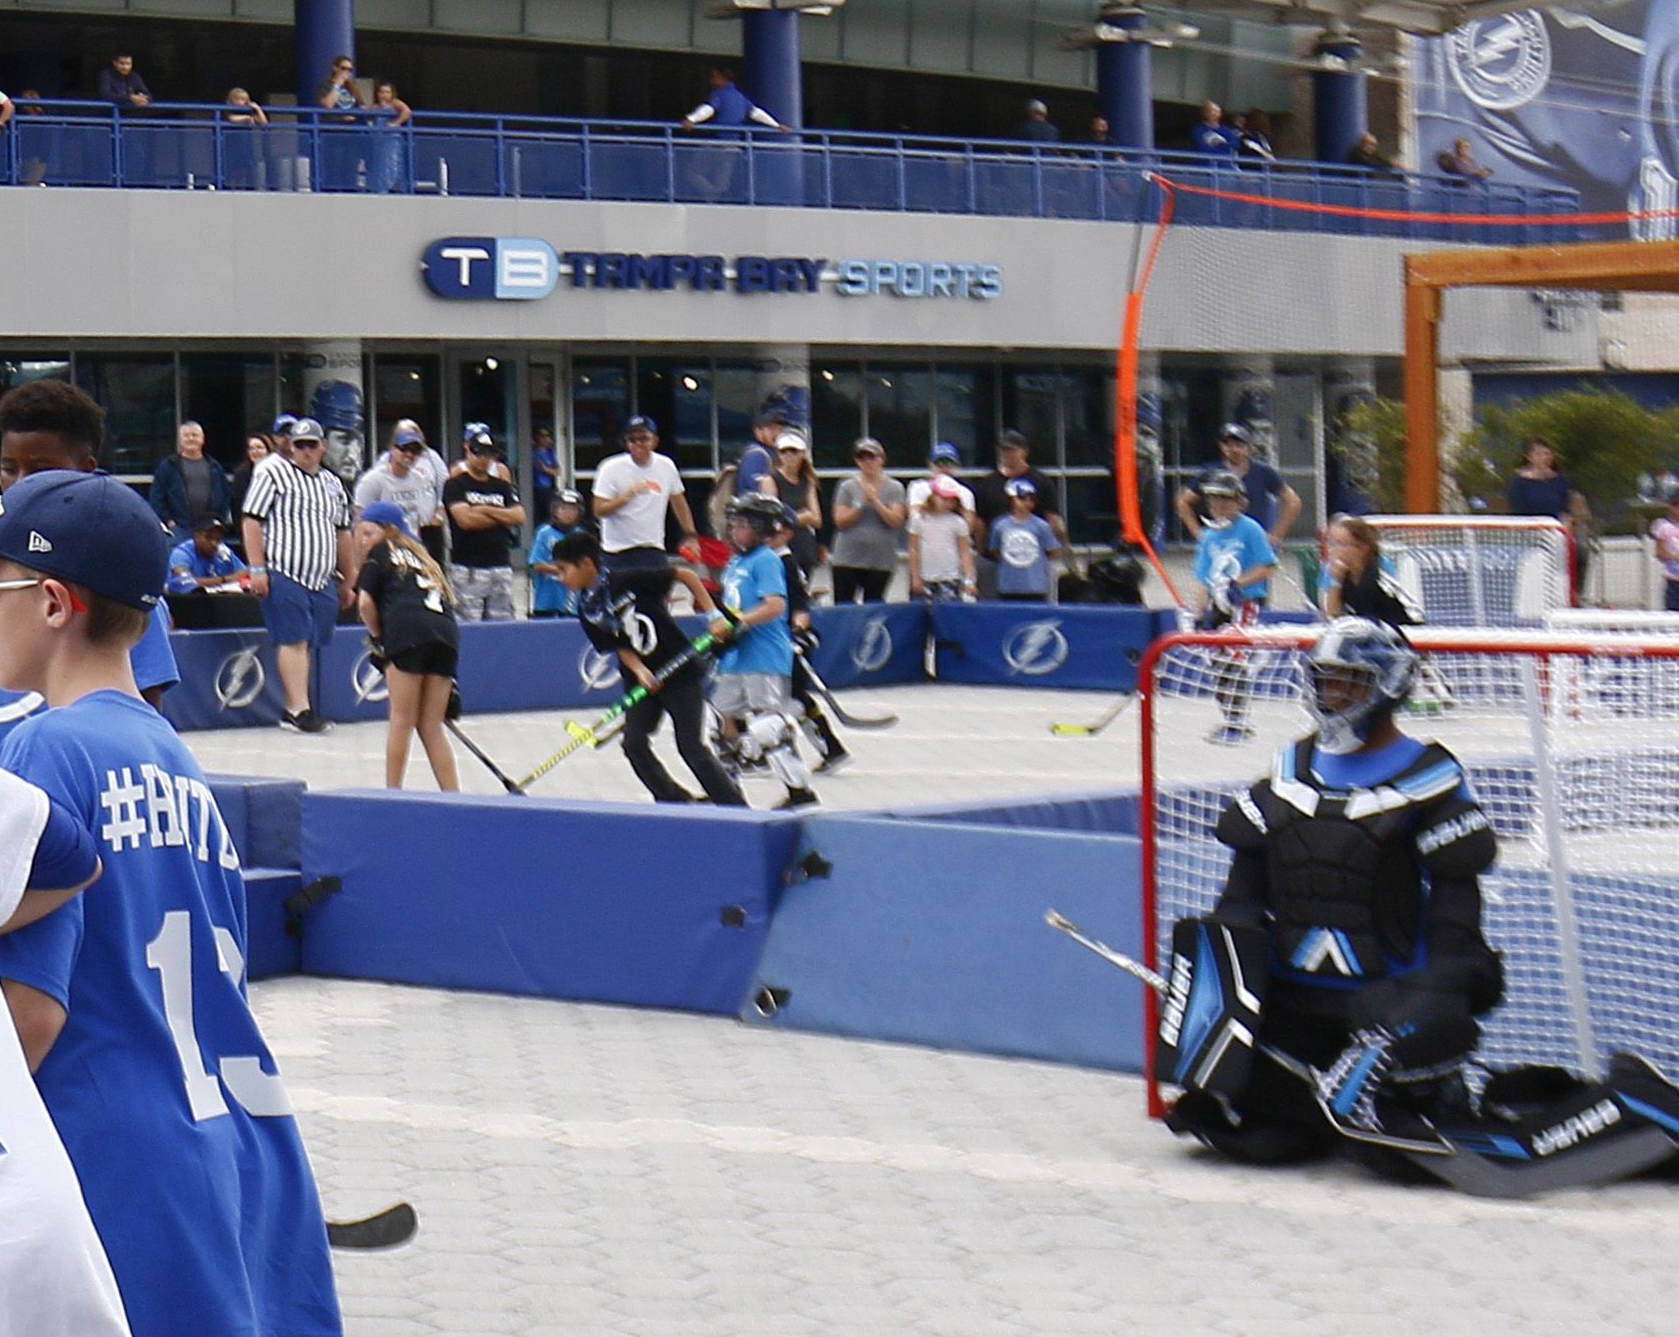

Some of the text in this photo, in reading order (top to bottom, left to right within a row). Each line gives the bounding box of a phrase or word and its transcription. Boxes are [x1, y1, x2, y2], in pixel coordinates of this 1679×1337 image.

[441, 247, 1003, 300] TB TAMPA BAY SPORTS
